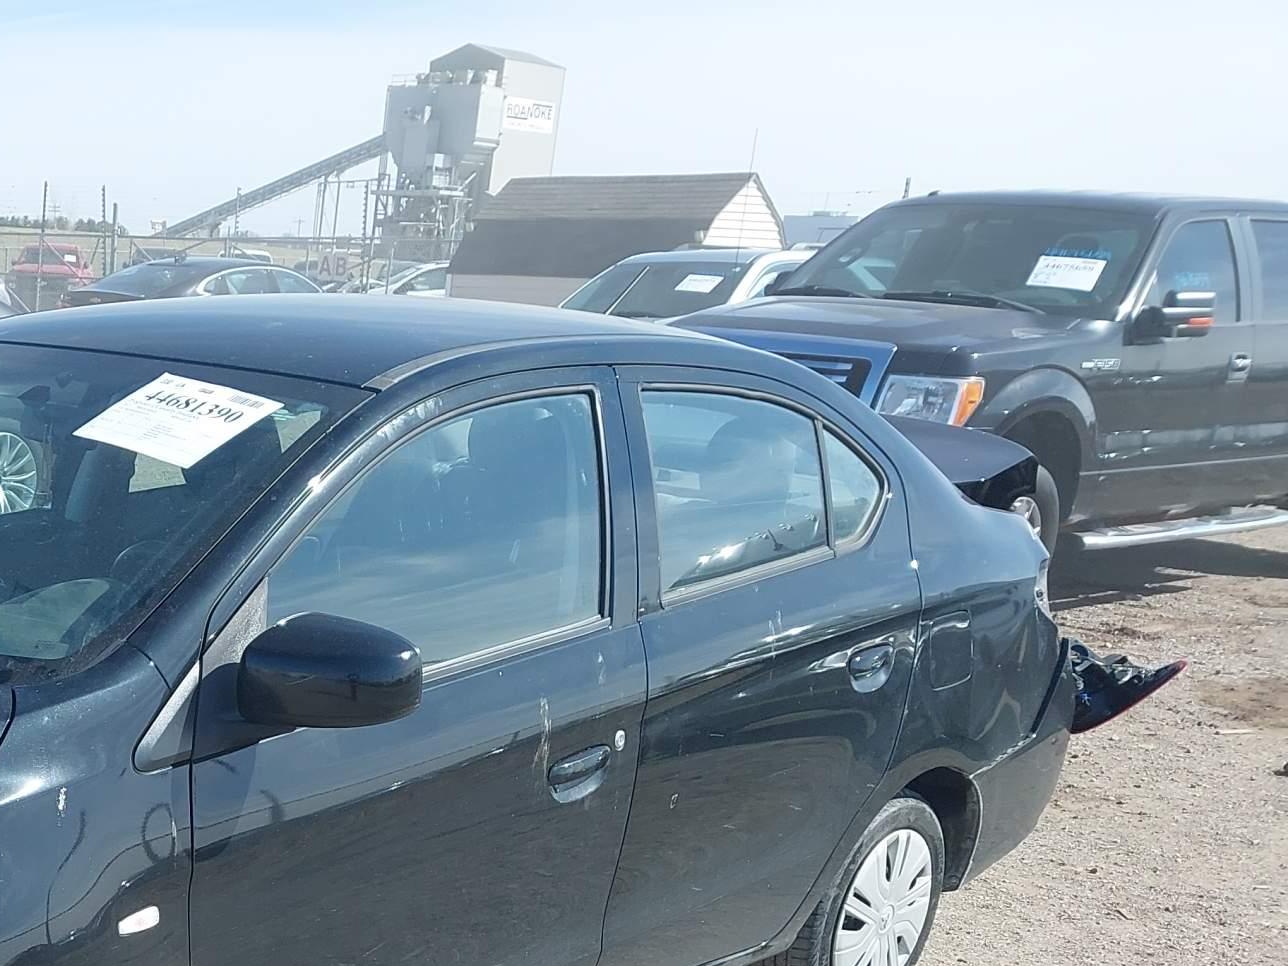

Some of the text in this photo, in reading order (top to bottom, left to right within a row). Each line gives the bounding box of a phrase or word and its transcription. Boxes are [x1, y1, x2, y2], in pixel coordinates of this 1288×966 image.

[507, 103, 553, 121] ROANOKE
[319, 255, 347, 276] AB
[143, 390, 245, 424] 44681390
